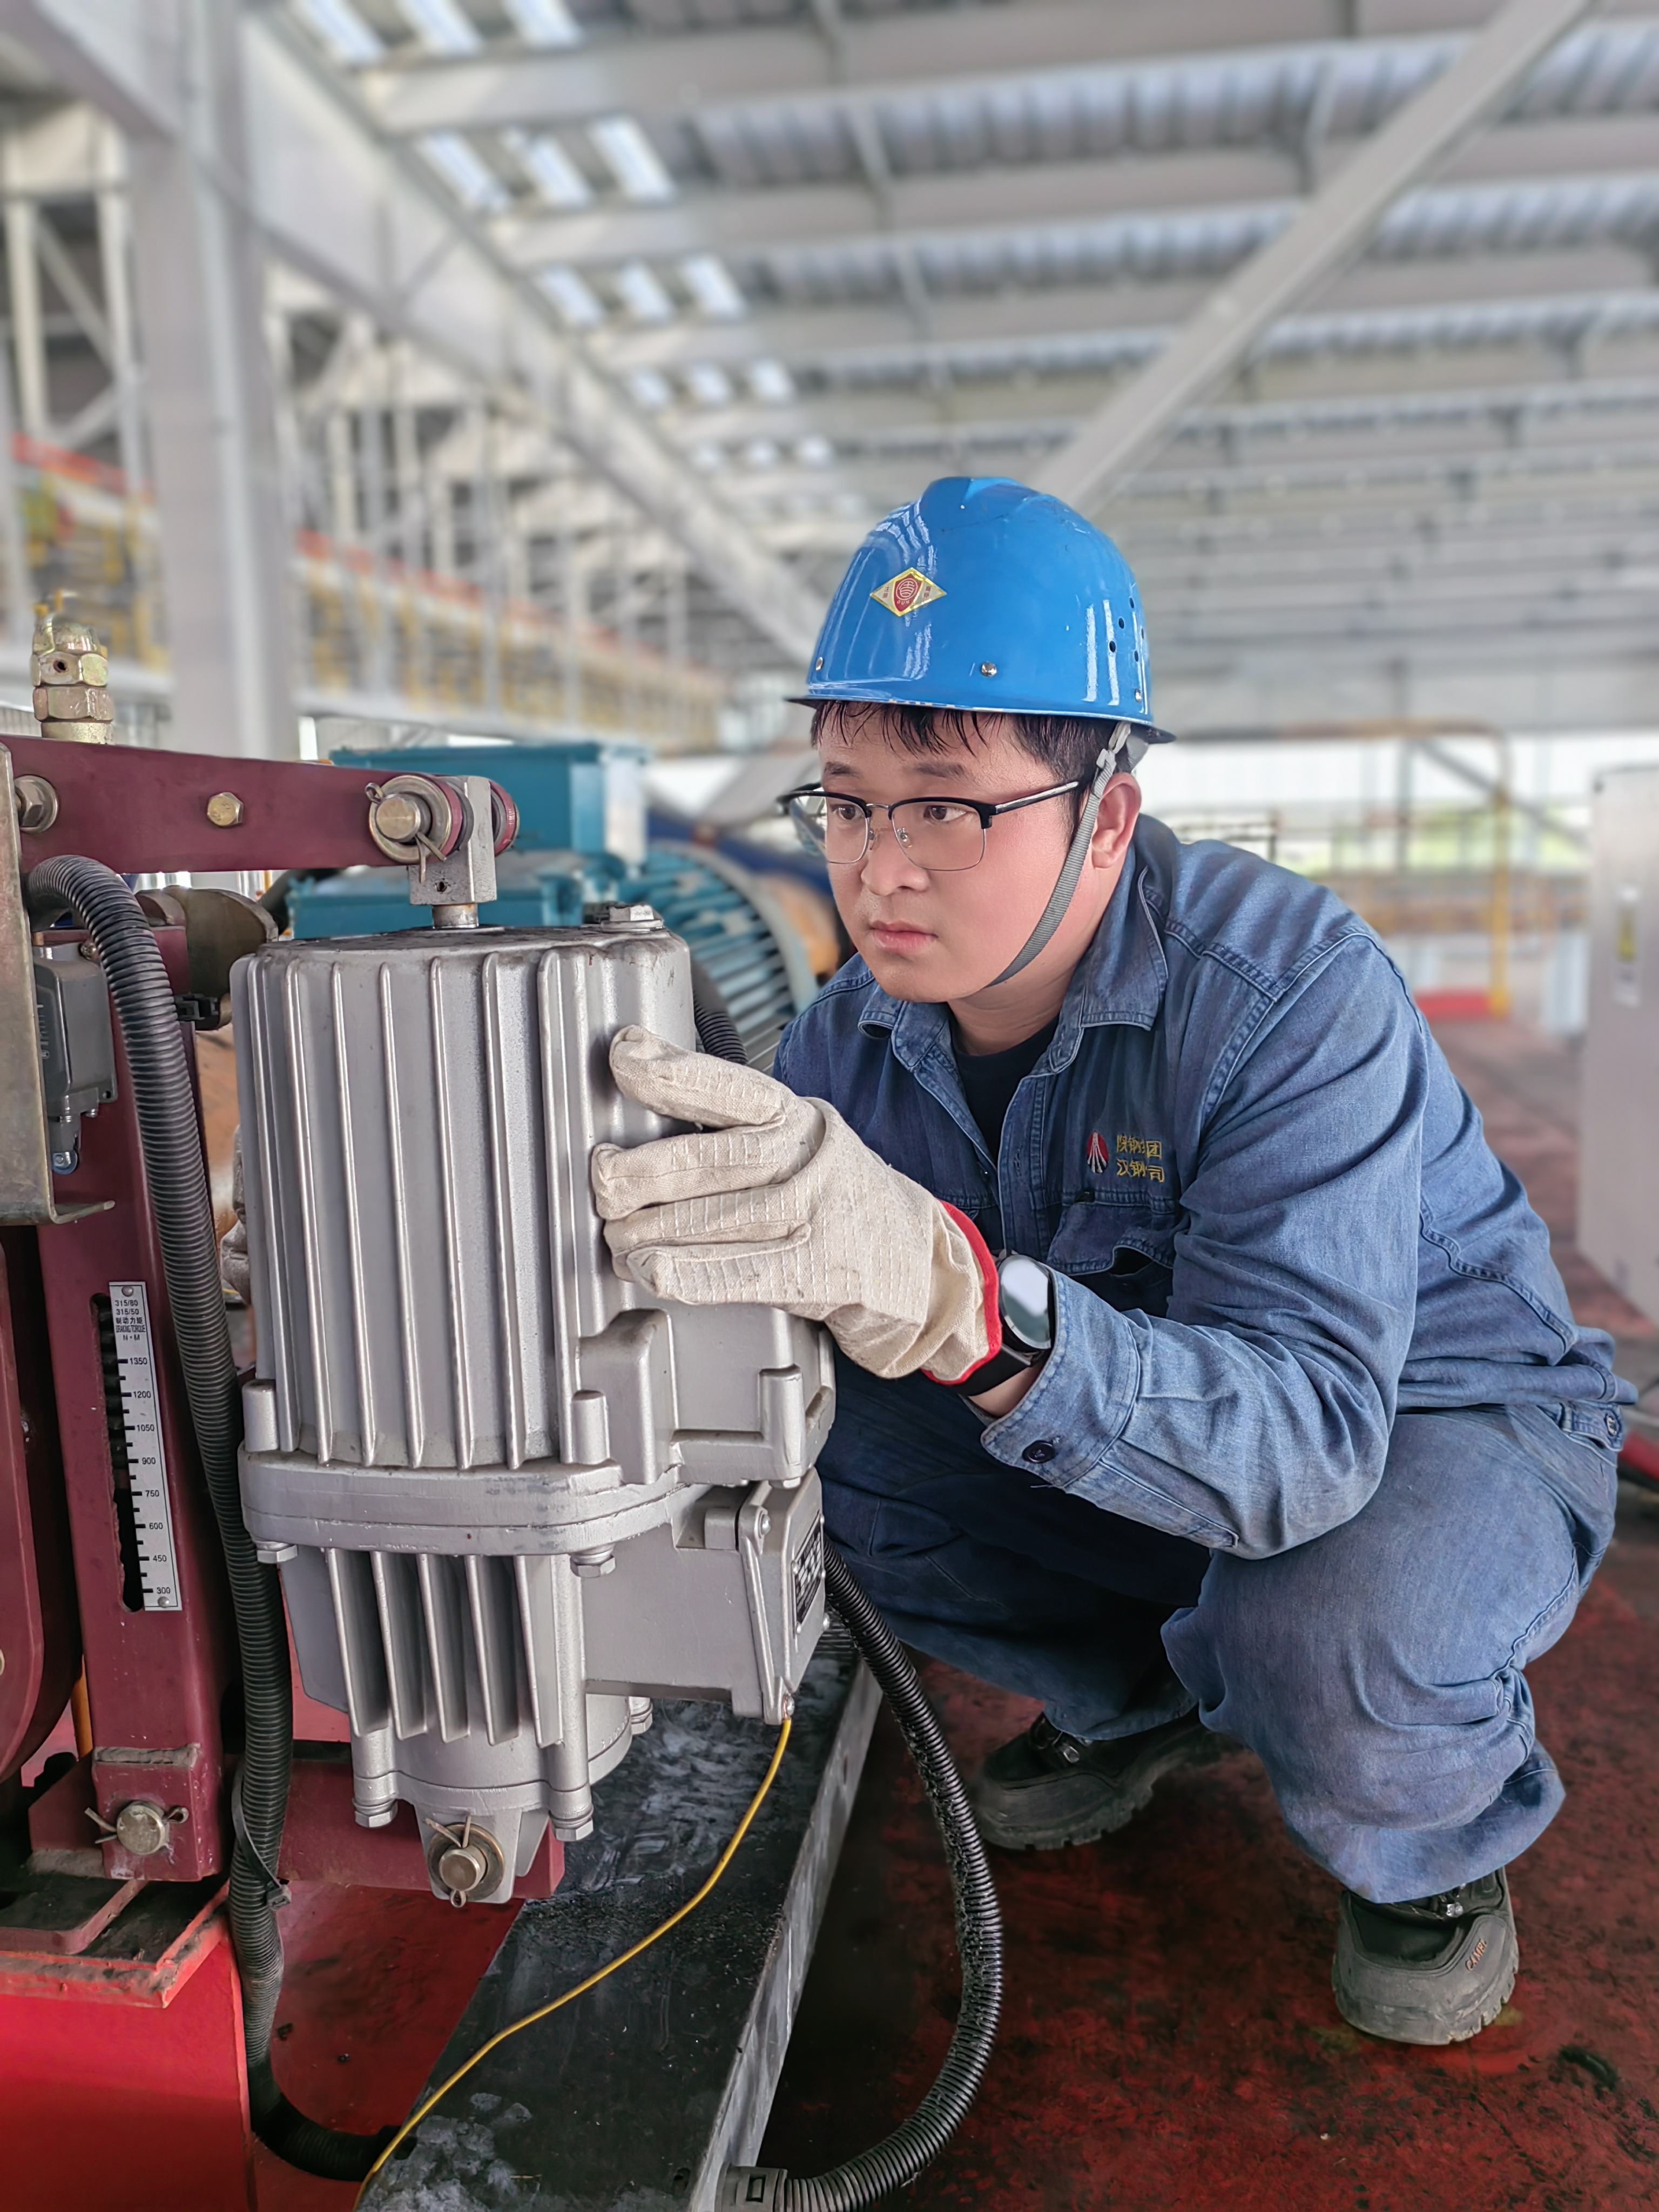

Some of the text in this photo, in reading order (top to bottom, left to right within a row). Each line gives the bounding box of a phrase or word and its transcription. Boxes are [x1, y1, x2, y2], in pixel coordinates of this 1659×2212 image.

[116, 1317, 143, 1325] 制动力矩
[1465, 1938, 1487, 1971] CAMEL
